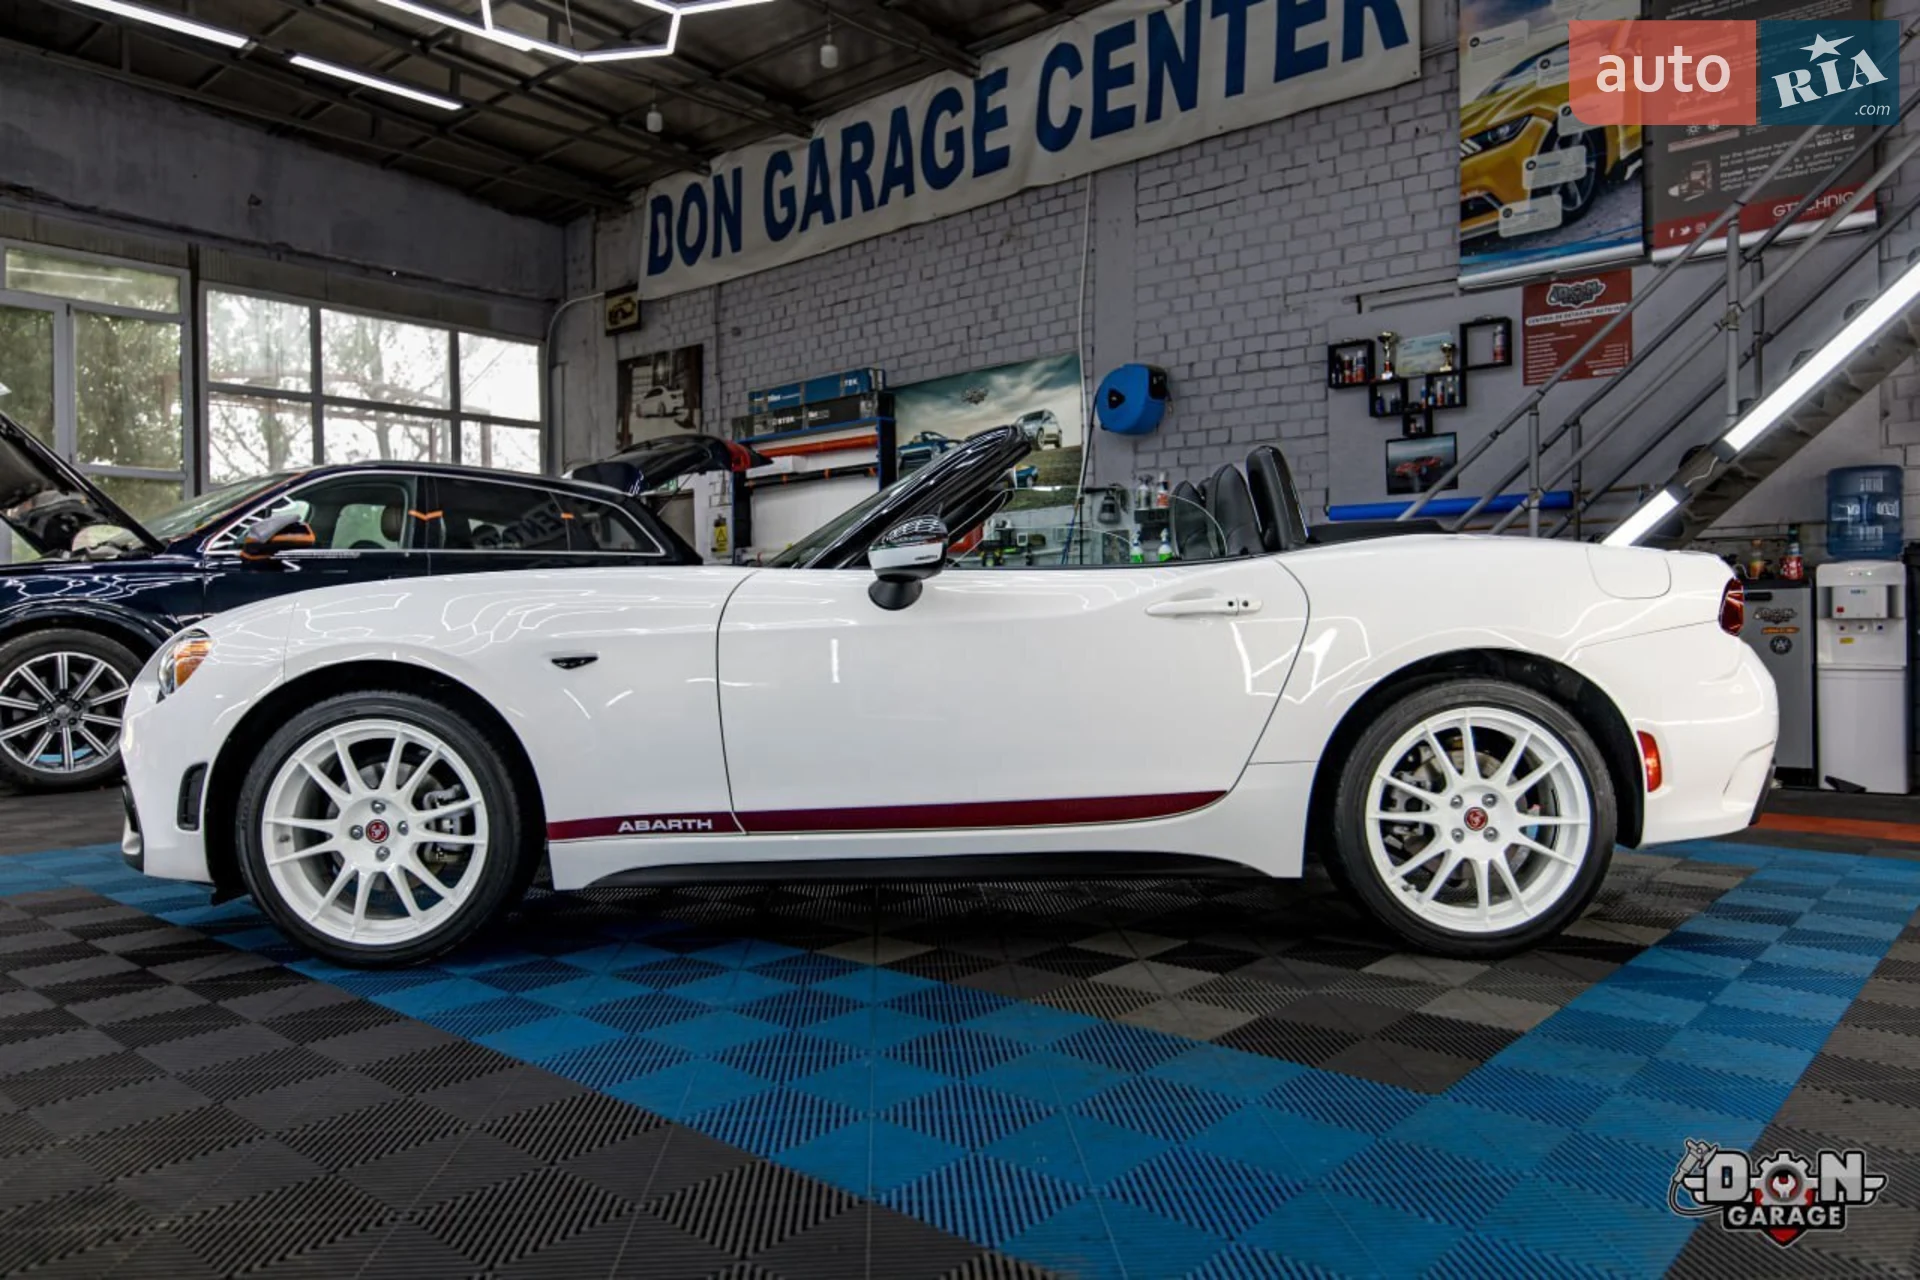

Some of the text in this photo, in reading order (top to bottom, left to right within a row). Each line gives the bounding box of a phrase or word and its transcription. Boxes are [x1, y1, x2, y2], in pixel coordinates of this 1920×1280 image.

[646, 166, 743, 277] DON
[763, 67, 1011, 242] GARAGE
[618, 818, 713, 832] ABARTH
